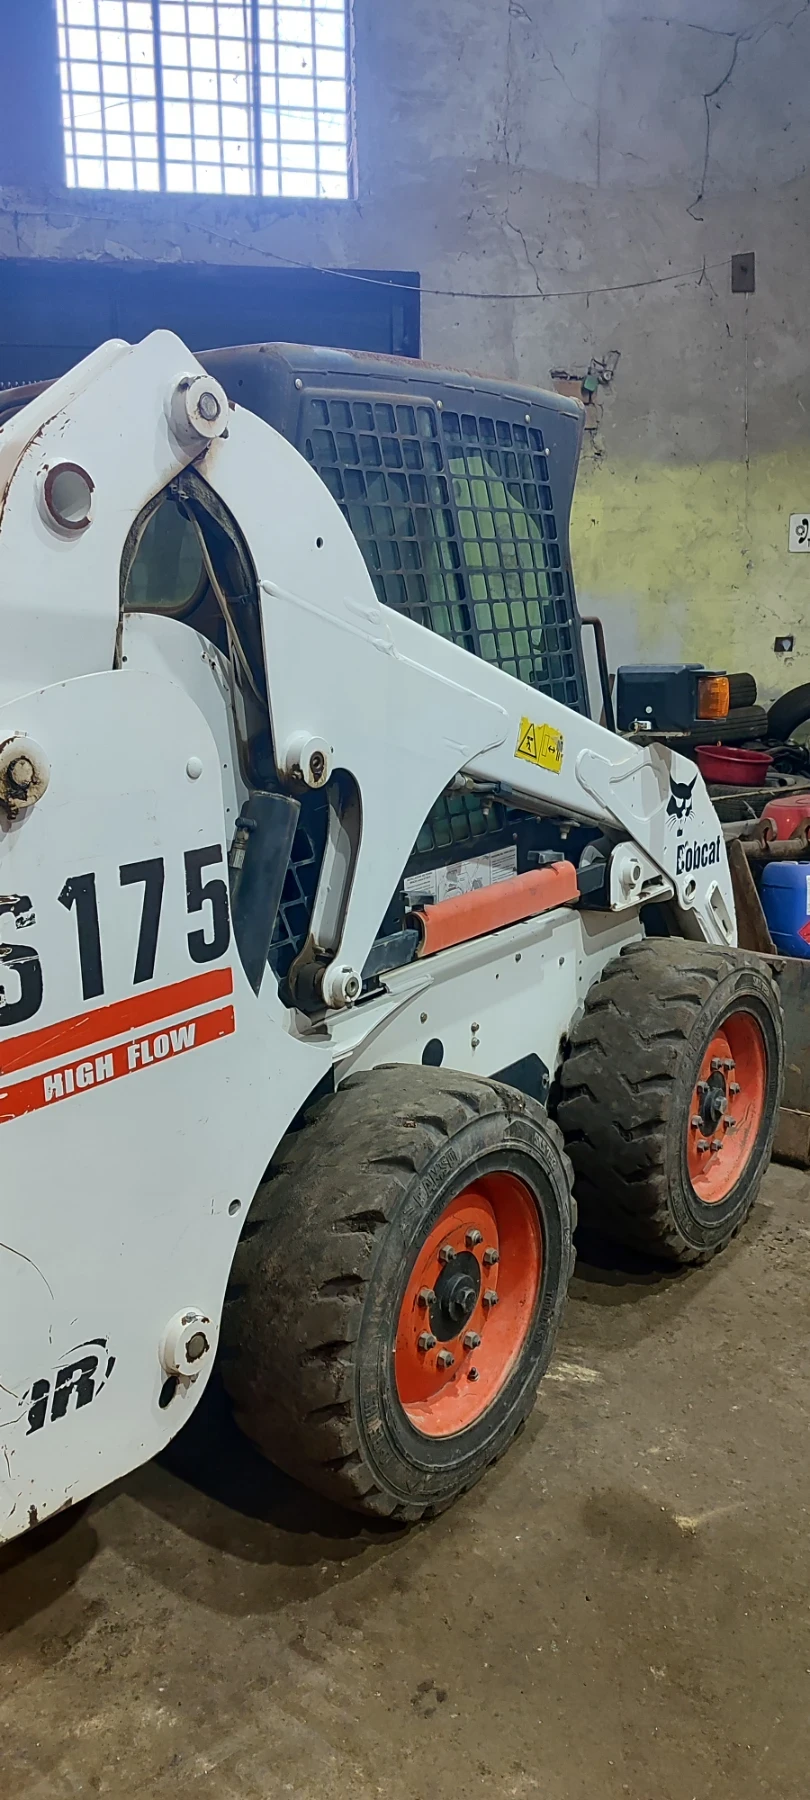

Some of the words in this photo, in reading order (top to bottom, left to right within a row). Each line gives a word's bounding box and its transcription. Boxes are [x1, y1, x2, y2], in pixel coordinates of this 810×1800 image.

[676, 835, 721, 876] Bobcat
[43, 1053, 114, 1102] HIGH
[127, 1022, 196, 1070] FLOW
